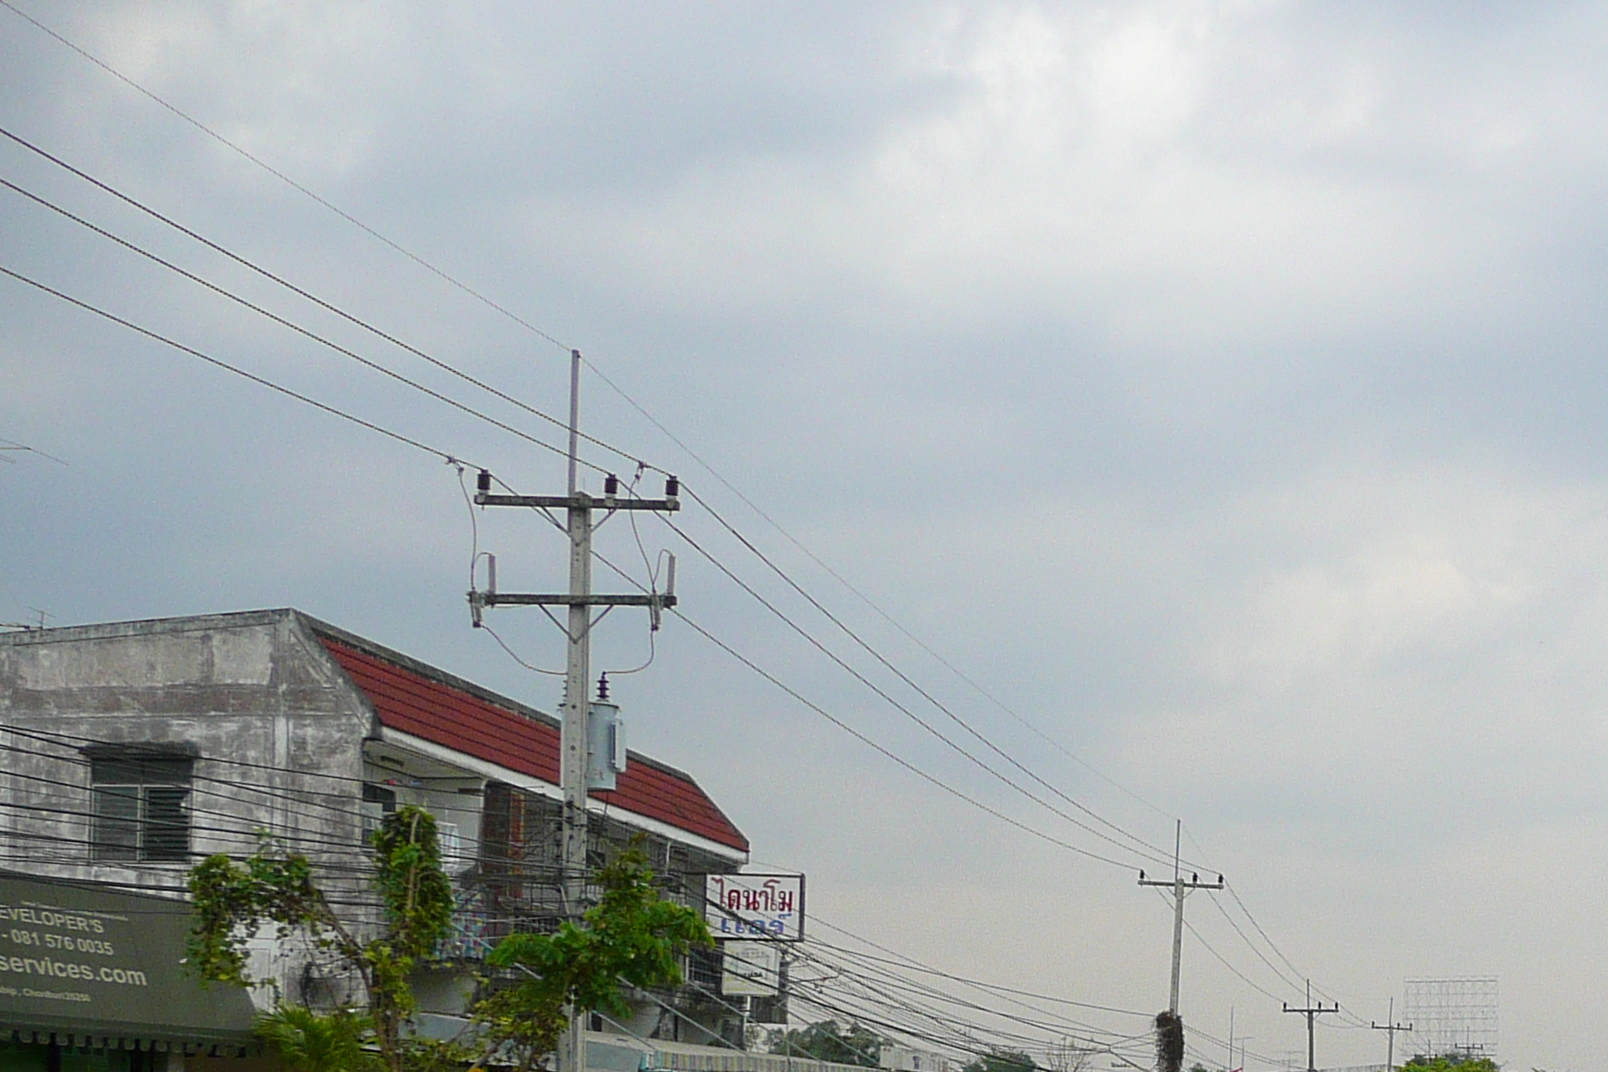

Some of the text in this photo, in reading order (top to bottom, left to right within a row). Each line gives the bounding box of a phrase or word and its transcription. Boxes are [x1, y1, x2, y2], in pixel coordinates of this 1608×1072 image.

[711, 877, 793, 912] ไดนาโม
[10, 929, 41, 946] 081
[45, 934, 75, 950] 576
[77, 938, 114, 956] 0035
